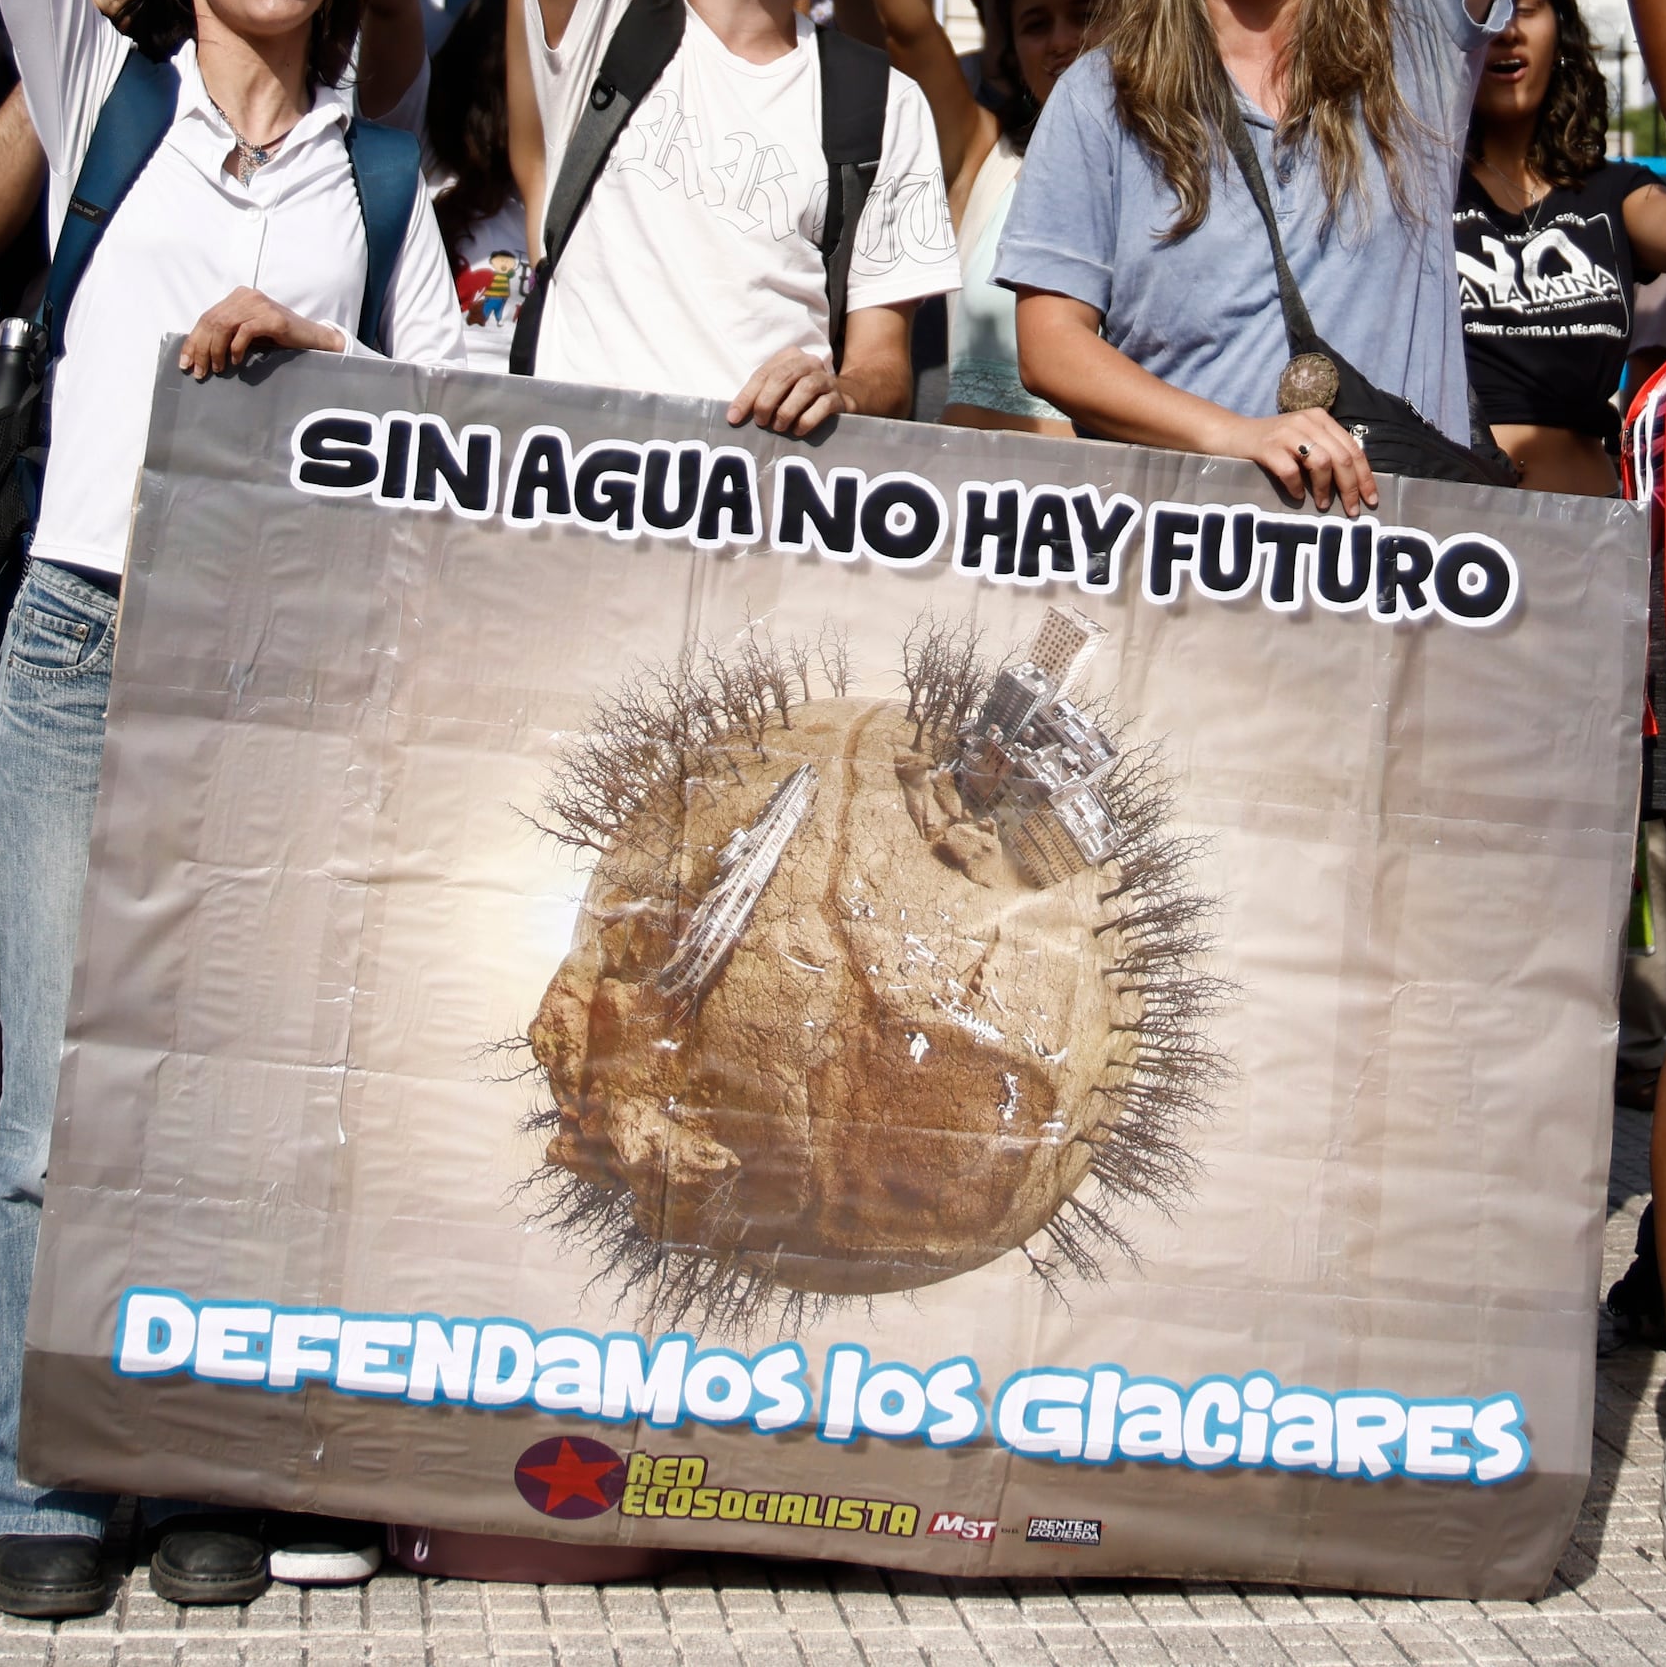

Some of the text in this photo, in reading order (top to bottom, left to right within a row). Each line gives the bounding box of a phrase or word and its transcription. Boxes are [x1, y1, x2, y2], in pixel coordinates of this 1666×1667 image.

[1532, 264, 1619, 303] MINA
[297, 415, 1513, 620] SIN AGUA NO HAY FUTURO
[628, 1453, 706, 1488] RED
[619, 1485, 920, 1537] ECOSOCIALISTA
[933, 1515, 998, 1539] MST
[1030, 1519, 1084, 1532] FRENTE
[1084, 1523, 1098, 1532] DE
[1027, 1529, 1100, 1541] IZQUIERDA
